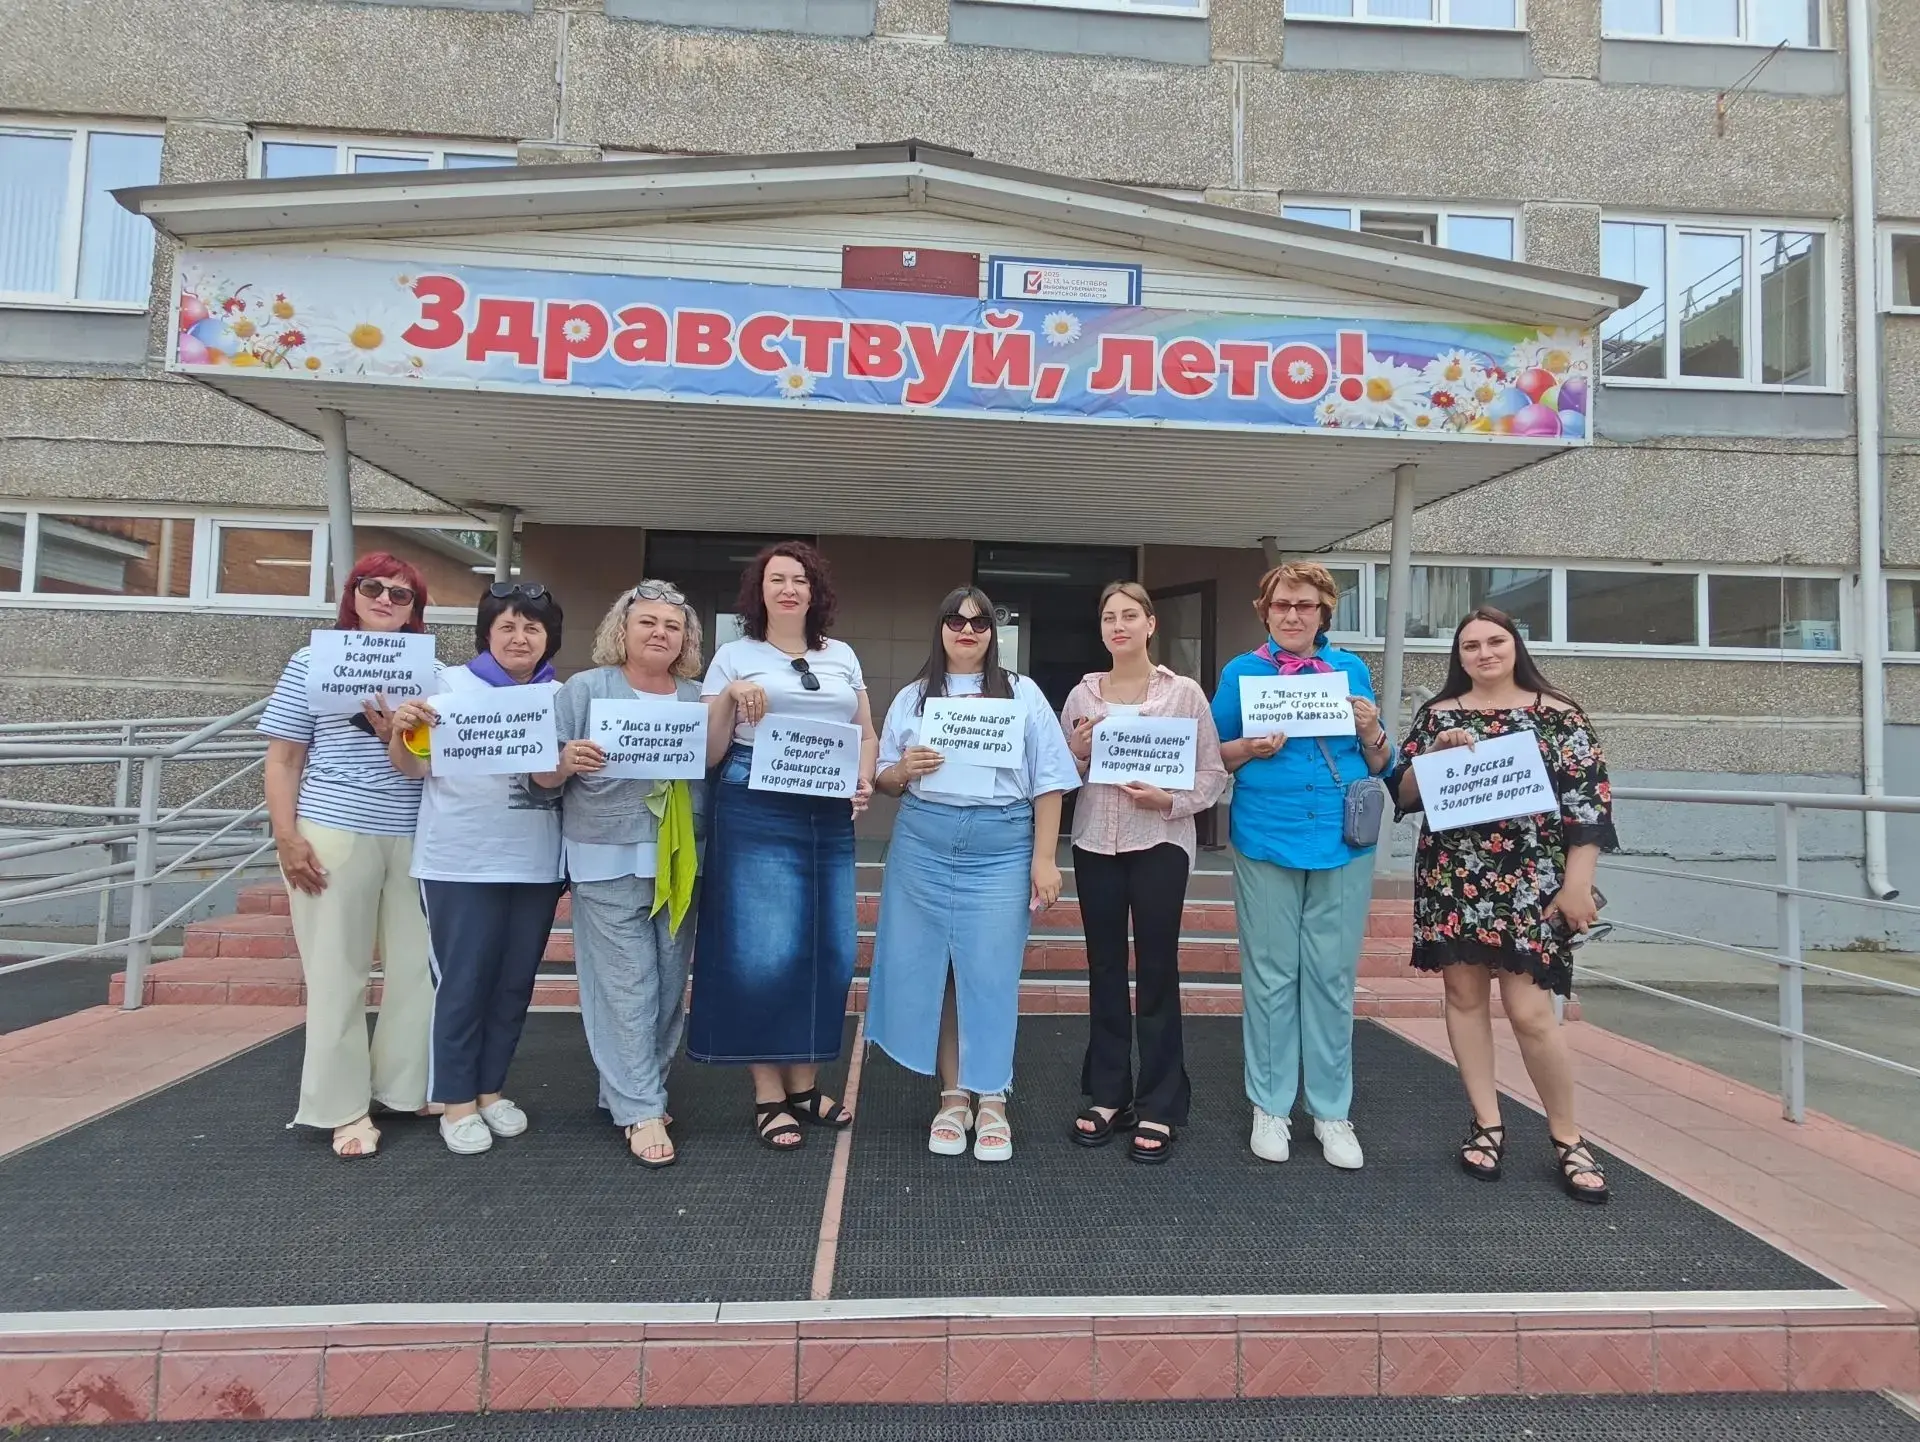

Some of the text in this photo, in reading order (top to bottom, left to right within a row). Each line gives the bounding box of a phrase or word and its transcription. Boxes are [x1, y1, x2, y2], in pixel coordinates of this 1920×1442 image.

[400, 274, 1366, 405] Здравствуй, лето!
[343, 634, 406, 648] 1. "Ловкий
[345, 651, 402, 665] всадник"
[333, 664, 413, 680] (Калмыцкая
[321, 682, 422, 696] народная игра)
[1261, 689, 1328, 700] 7. "Пастух и
[1253, 700, 1339, 710] овцы" (Горских
[435, 709, 548, 726] 2. "Слепой олень"
[933, 711, 1016, 725] 5. "Семь шагов"
[1248, 710, 1349, 722] народов Кавказа)
[600, 719, 701, 734] 3. "Лиса и куры"
[942, 723, 1005, 738] (Чувашская
[458, 728, 526, 742] (Ненецкая
[618, 734, 683, 749] (Татарская
[771, 729, 844, 748] 4. "Медведь в
[1099, 731, 1191, 747] 6. "Белый олень"
[443, 741, 544, 759] народная игра)
[784, 745, 831, 760] берлоге"
[930, 737, 1013, 753] народная игра)
[1108, 744, 1180, 760] (Эвенкийская
[663, 751, 695, 764] игра)
[771, 758, 841, 776] (Башкирская
[1101, 760, 1185, 775] народная игра)
[1445, 755, 1515, 779] 8. Русская
[761, 774, 846, 792] народная игра)
[1439, 768, 1532, 796] народная игра
[1433, 783, 1545, 813] «Золотые ворота»
